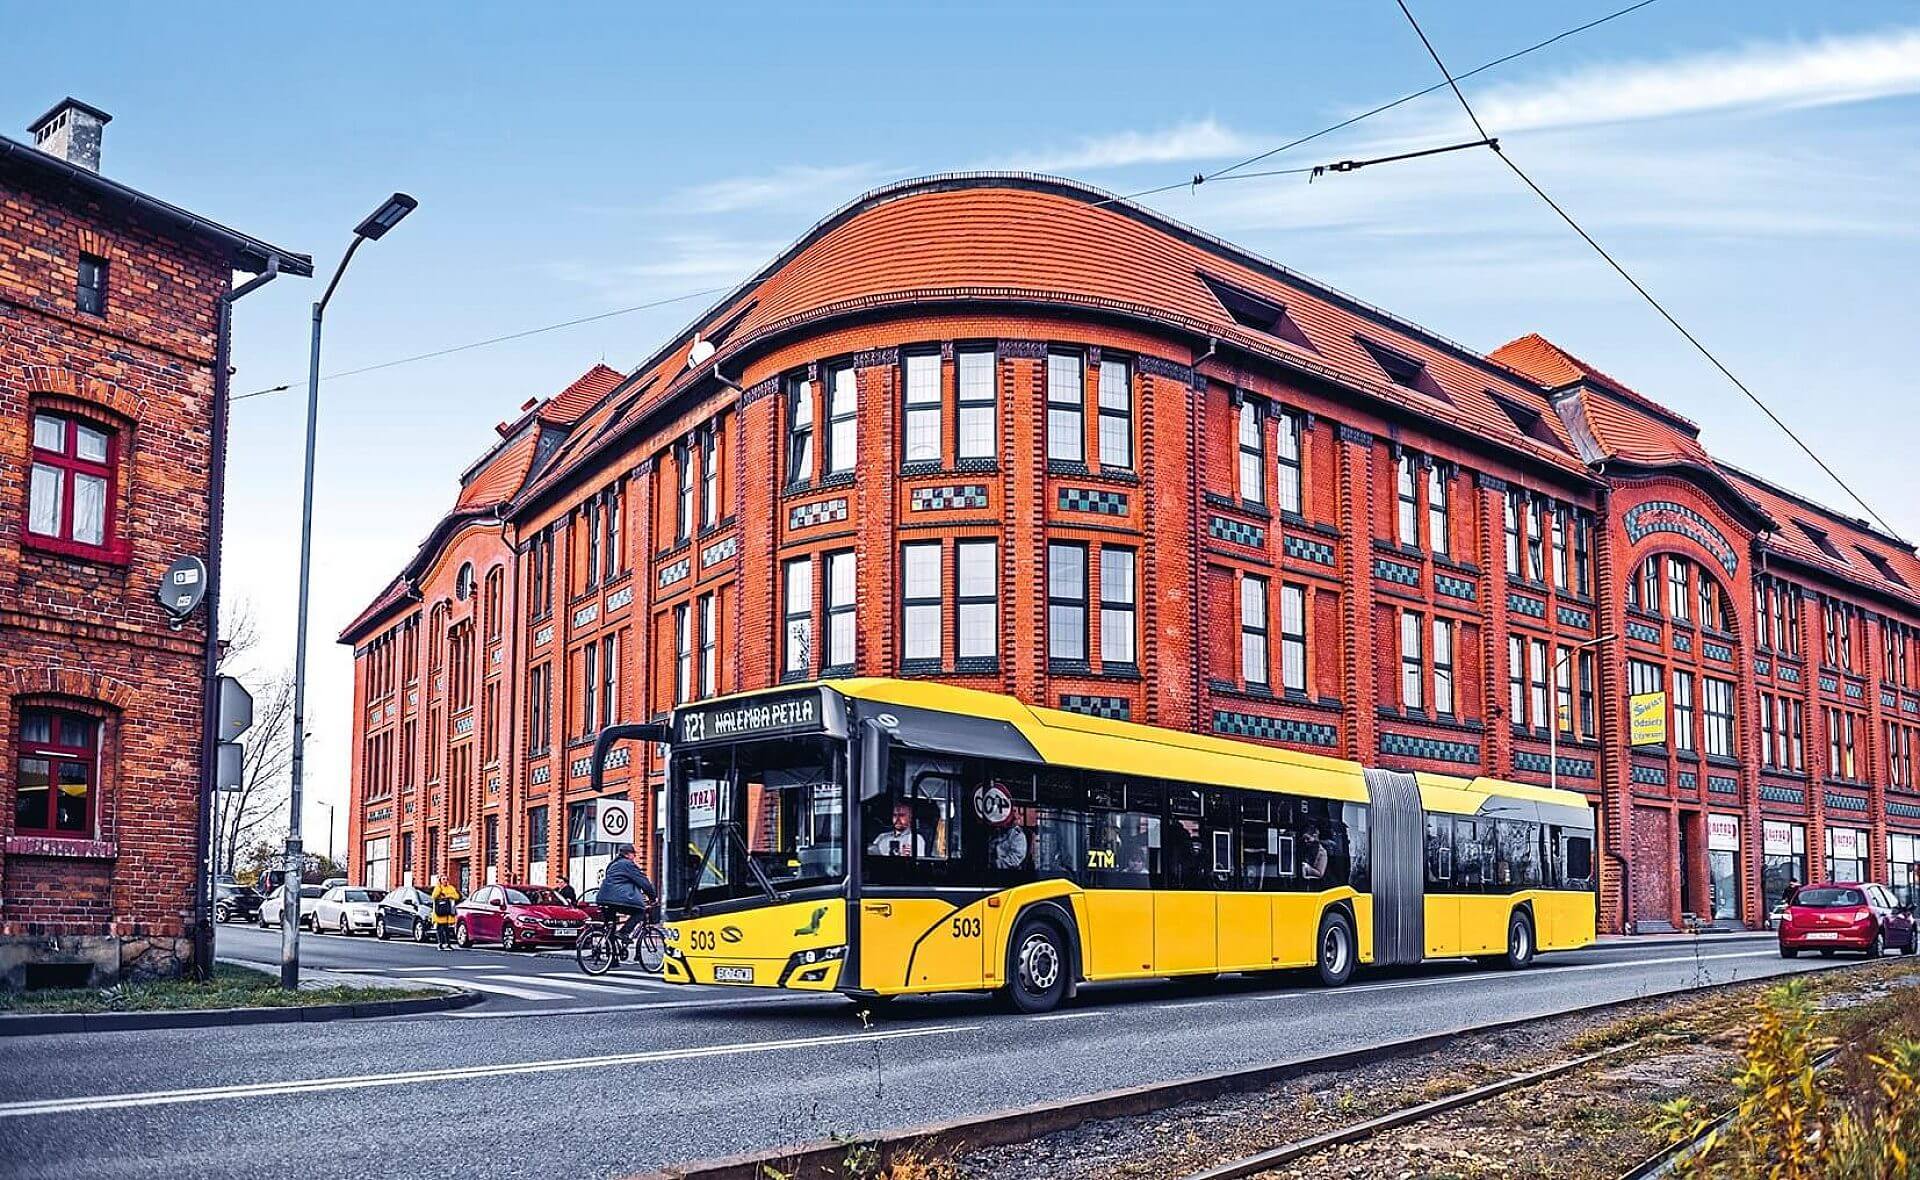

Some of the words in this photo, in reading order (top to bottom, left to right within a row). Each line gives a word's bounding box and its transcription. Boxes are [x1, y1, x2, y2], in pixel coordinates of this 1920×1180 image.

[684, 712, 706, 742] 121
[715, 706, 770, 734] HALEMBA
[606, 814, 625, 829] 20
[1087, 850, 1116, 869] ZTM
[952, 918, 981, 938] 503
[690, 930, 715, 950] 503
